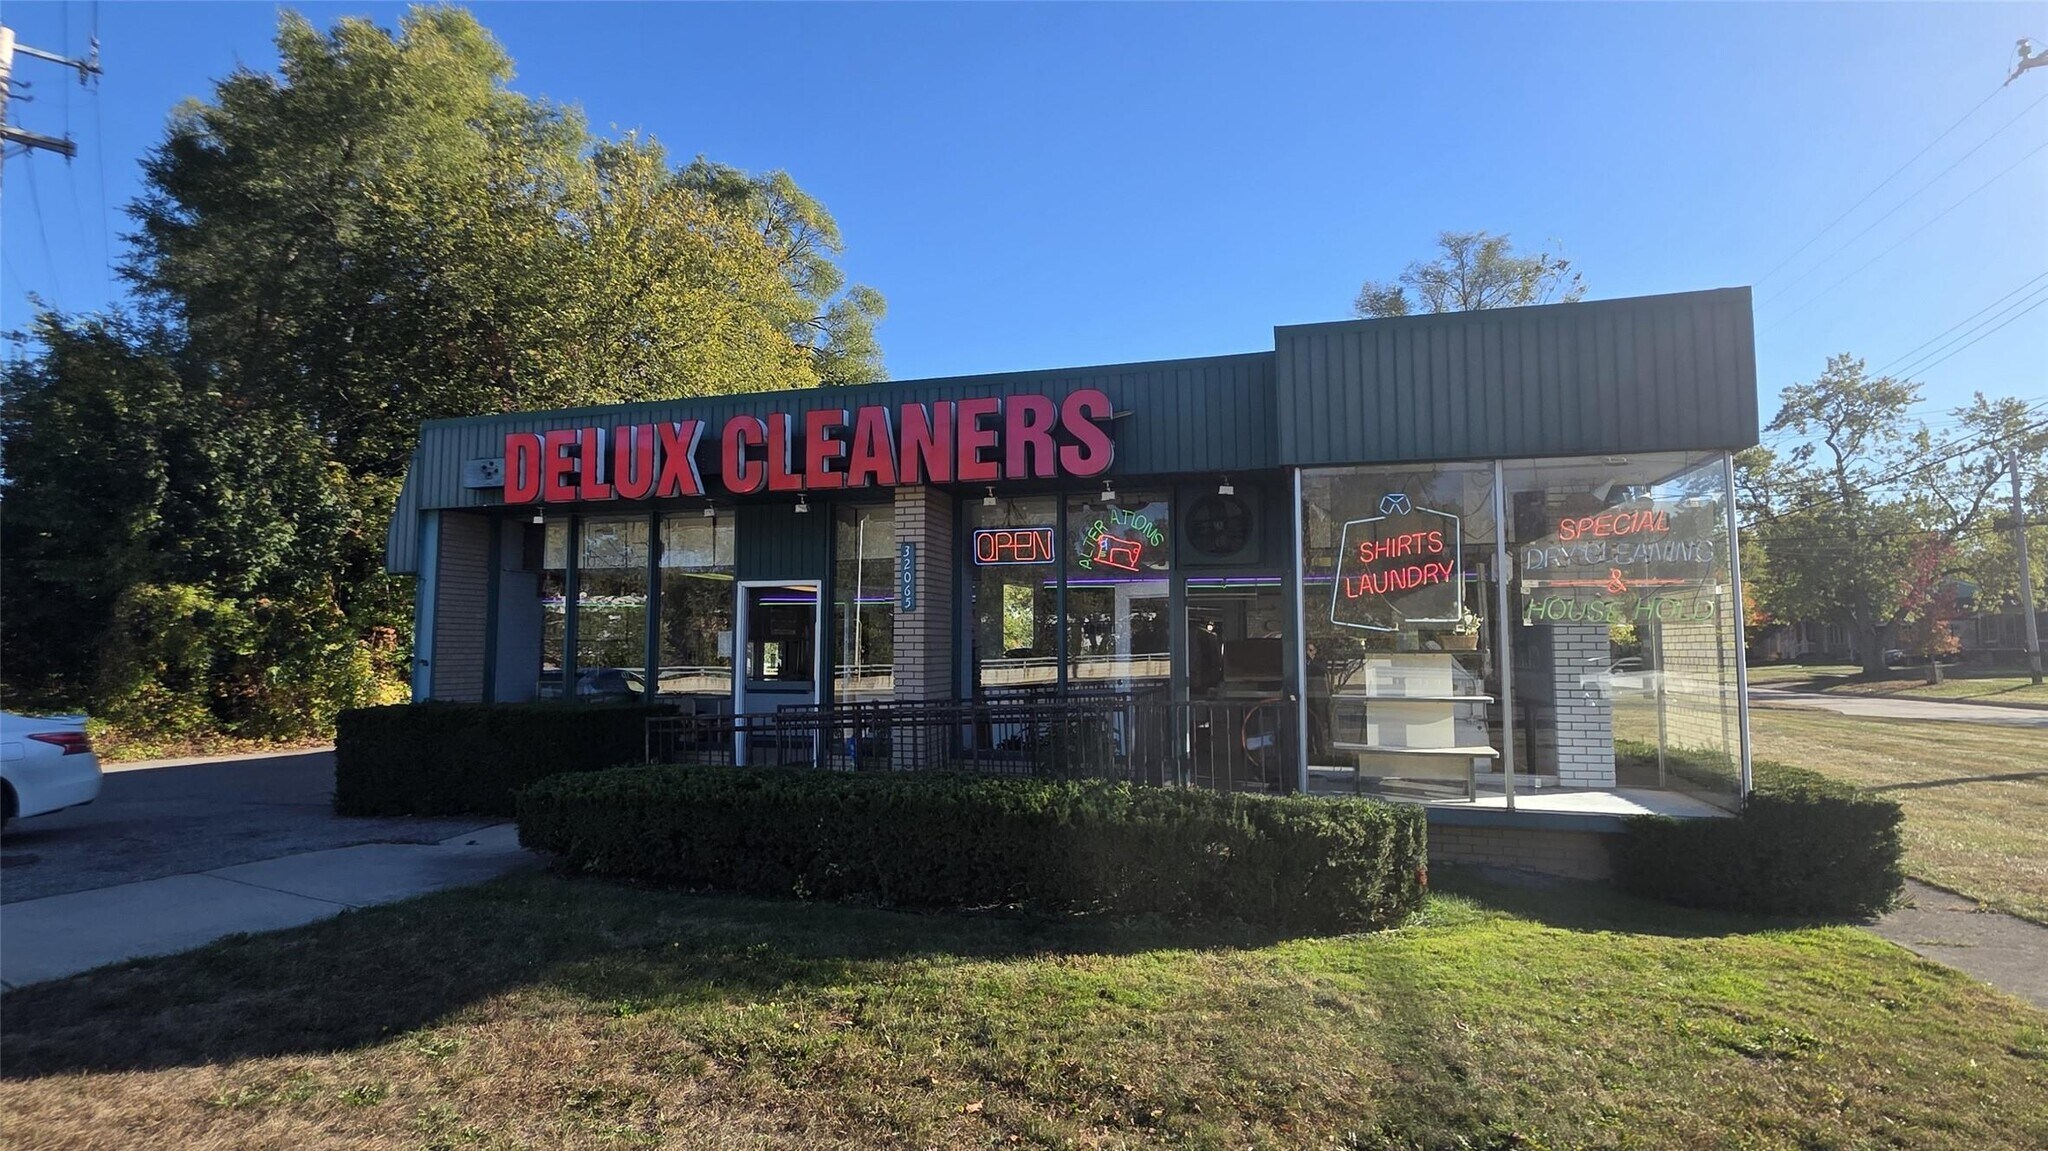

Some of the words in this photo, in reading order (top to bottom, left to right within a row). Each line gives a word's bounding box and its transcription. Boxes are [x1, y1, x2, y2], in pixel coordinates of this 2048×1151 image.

[504, 419, 705, 504] DELUX
[721, 388, 1113, 494] CLEANERS
[1559, 509, 1670, 541] SPECIAL
[976, 531, 1052, 562] OPEN
[1360, 530, 1443, 563] SHIRTS
[1526, 545, 1576, 570] DRY
[1583, 539, 1714, 566] CLEANING
[902, 544, 912, 609] 32065
[1345, 559, 1455, 599] LAUNDRY
[1607, 568, 1628, 594] &
[1526, 597, 1625, 622] HOUSE
[1634, 596, 1716, 621] HOLD
